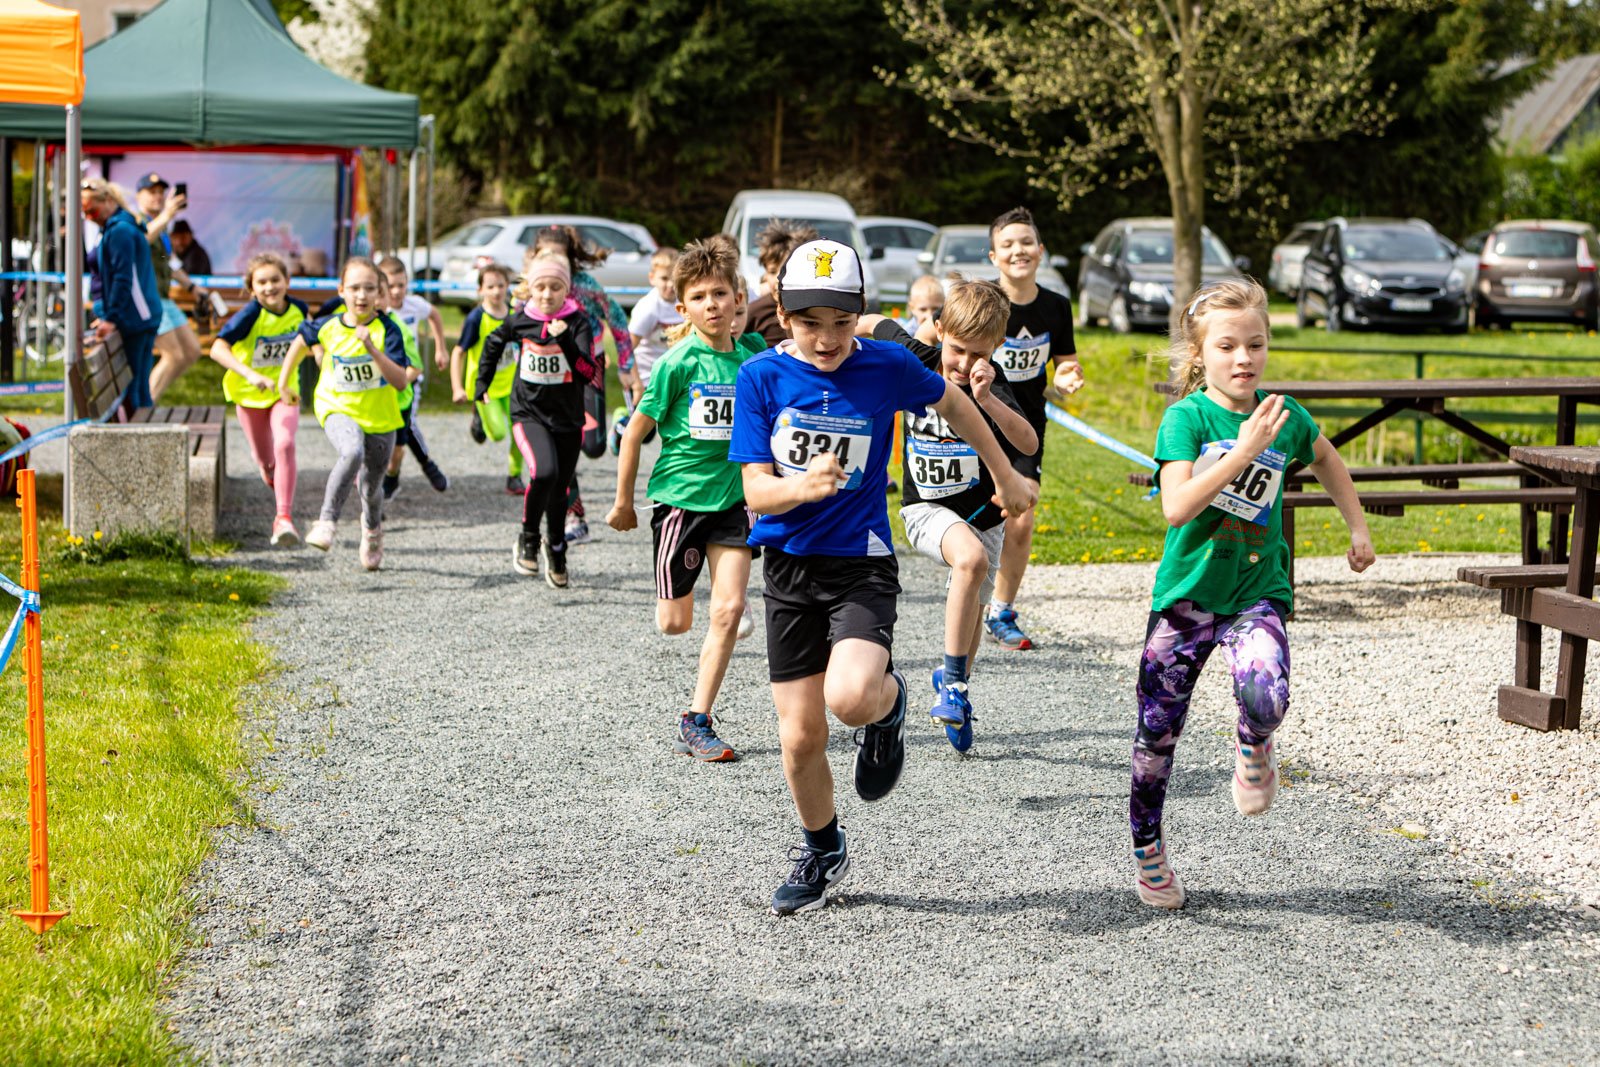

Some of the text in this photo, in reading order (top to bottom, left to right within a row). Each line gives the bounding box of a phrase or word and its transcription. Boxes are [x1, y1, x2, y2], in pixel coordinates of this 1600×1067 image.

[529, 354, 560, 374] 388
[1004, 348, 1040, 370] 332
[343, 363, 373, 382] 319
[703, 398, 733, 426] 34
[915, 456, 963, 485] 354
[1219, 452, 1272, 502] 46
